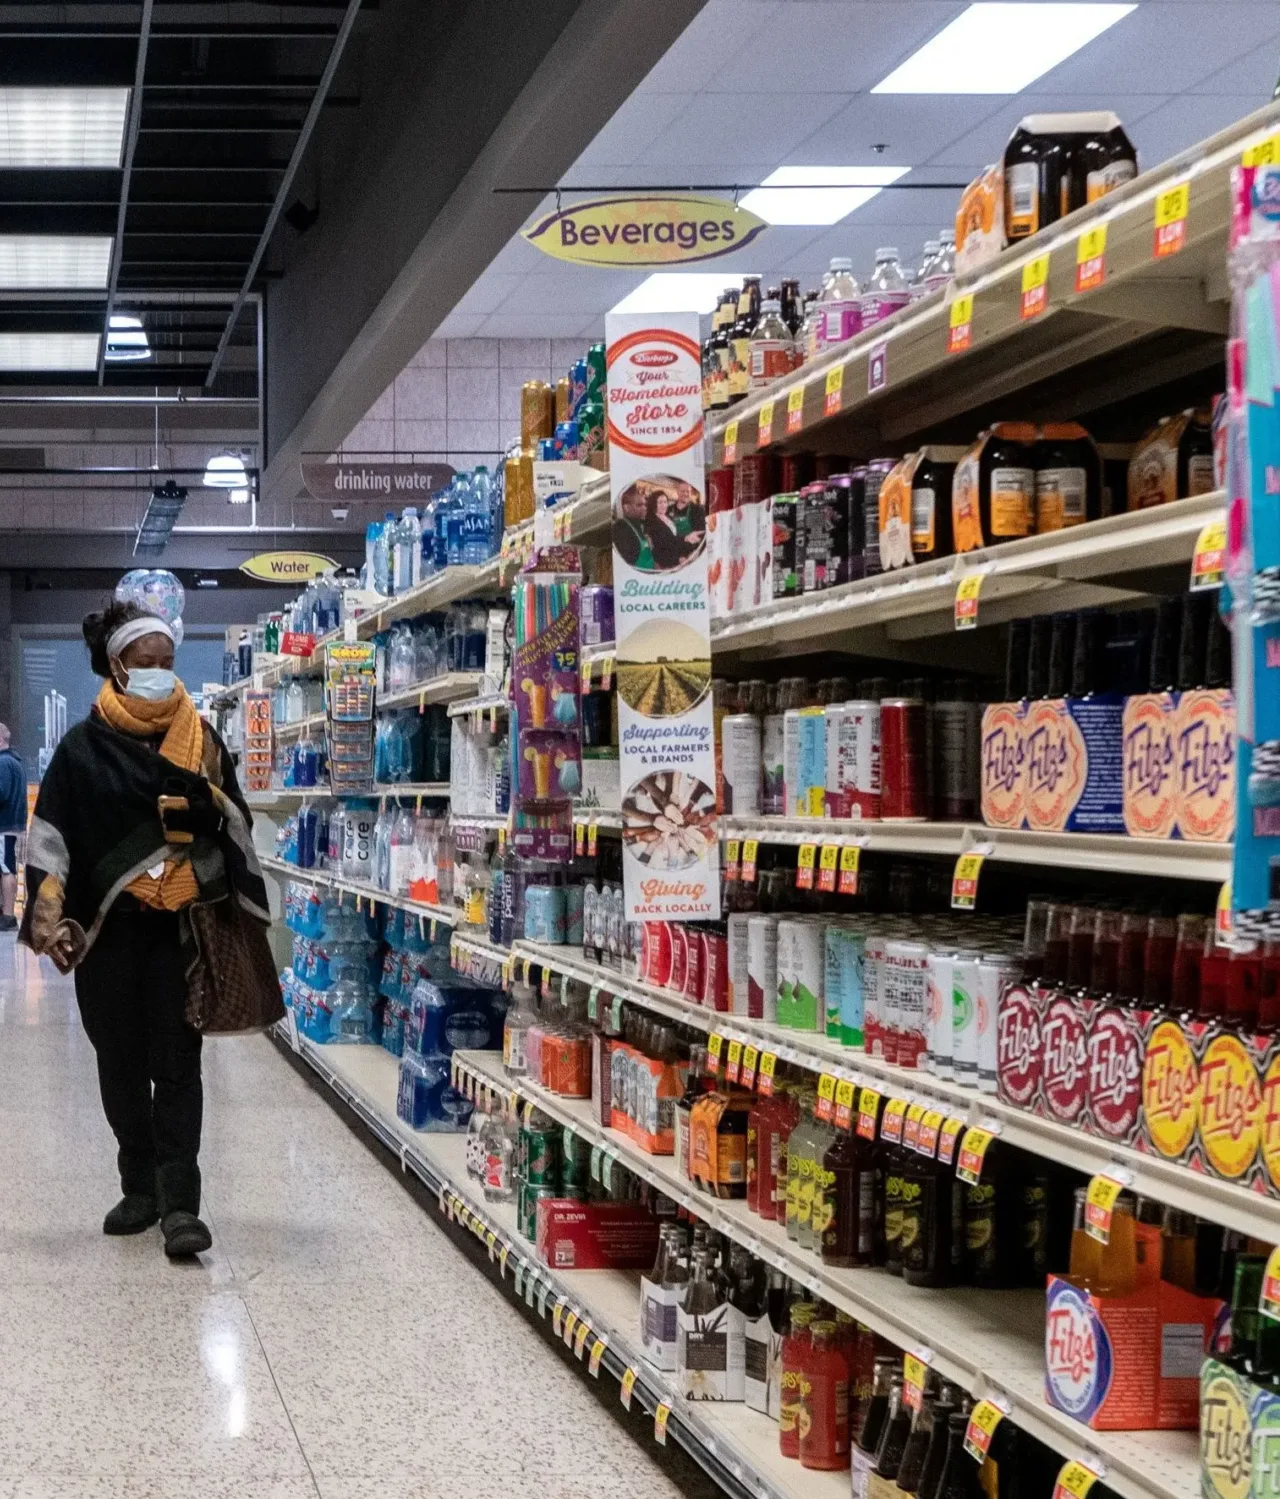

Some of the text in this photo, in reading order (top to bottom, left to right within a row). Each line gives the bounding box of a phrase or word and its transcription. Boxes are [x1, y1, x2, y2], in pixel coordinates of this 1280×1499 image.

[560, 217, 735, 248] Beverages
[636, 371, 669, 385] Your
[610, 385, 699, 404] Hometown
[626, 403, 688, 428] Store
[630, 426, 682, 435] SINCE 1854
[335, 469, 433, 494] drinking water
[270, 559, 310, 574] Water
[620, 579, 705, 600] Building
[620, 602, 706, 613] LOCAL CAREERS
[623, 724, 710, 742] Supporting
[625, 743, 710, 754] LOCAL FARMERS
[641, 754, 694, 764] & BRANDS
[984, 726, 1024, 793] Fitz's
[1025, 725, 1068, 793] Fitz's
[1125, 722, 1174, 797] Fitz's
[1178, 720, 1233, 798] Fitz's
[358, 821, 370, 861] core
[506, 874, 514, 919] penta
[640, 878, 706, 903] Giving
[634, 904, 711, 913] BACK LOCALLY
[999, 1004, 1040, 1074] Fitz's
[1042, 1017, 1088, 1090] Fitz's
[1089, 1028, 1141, 1105] Fitz's
[1145, 1045, 1199, 1118] Fitz's
[1199, 1059, 1261, 1141] Fitz's
[1047, 1308, 1098, 1384] Fitz's
